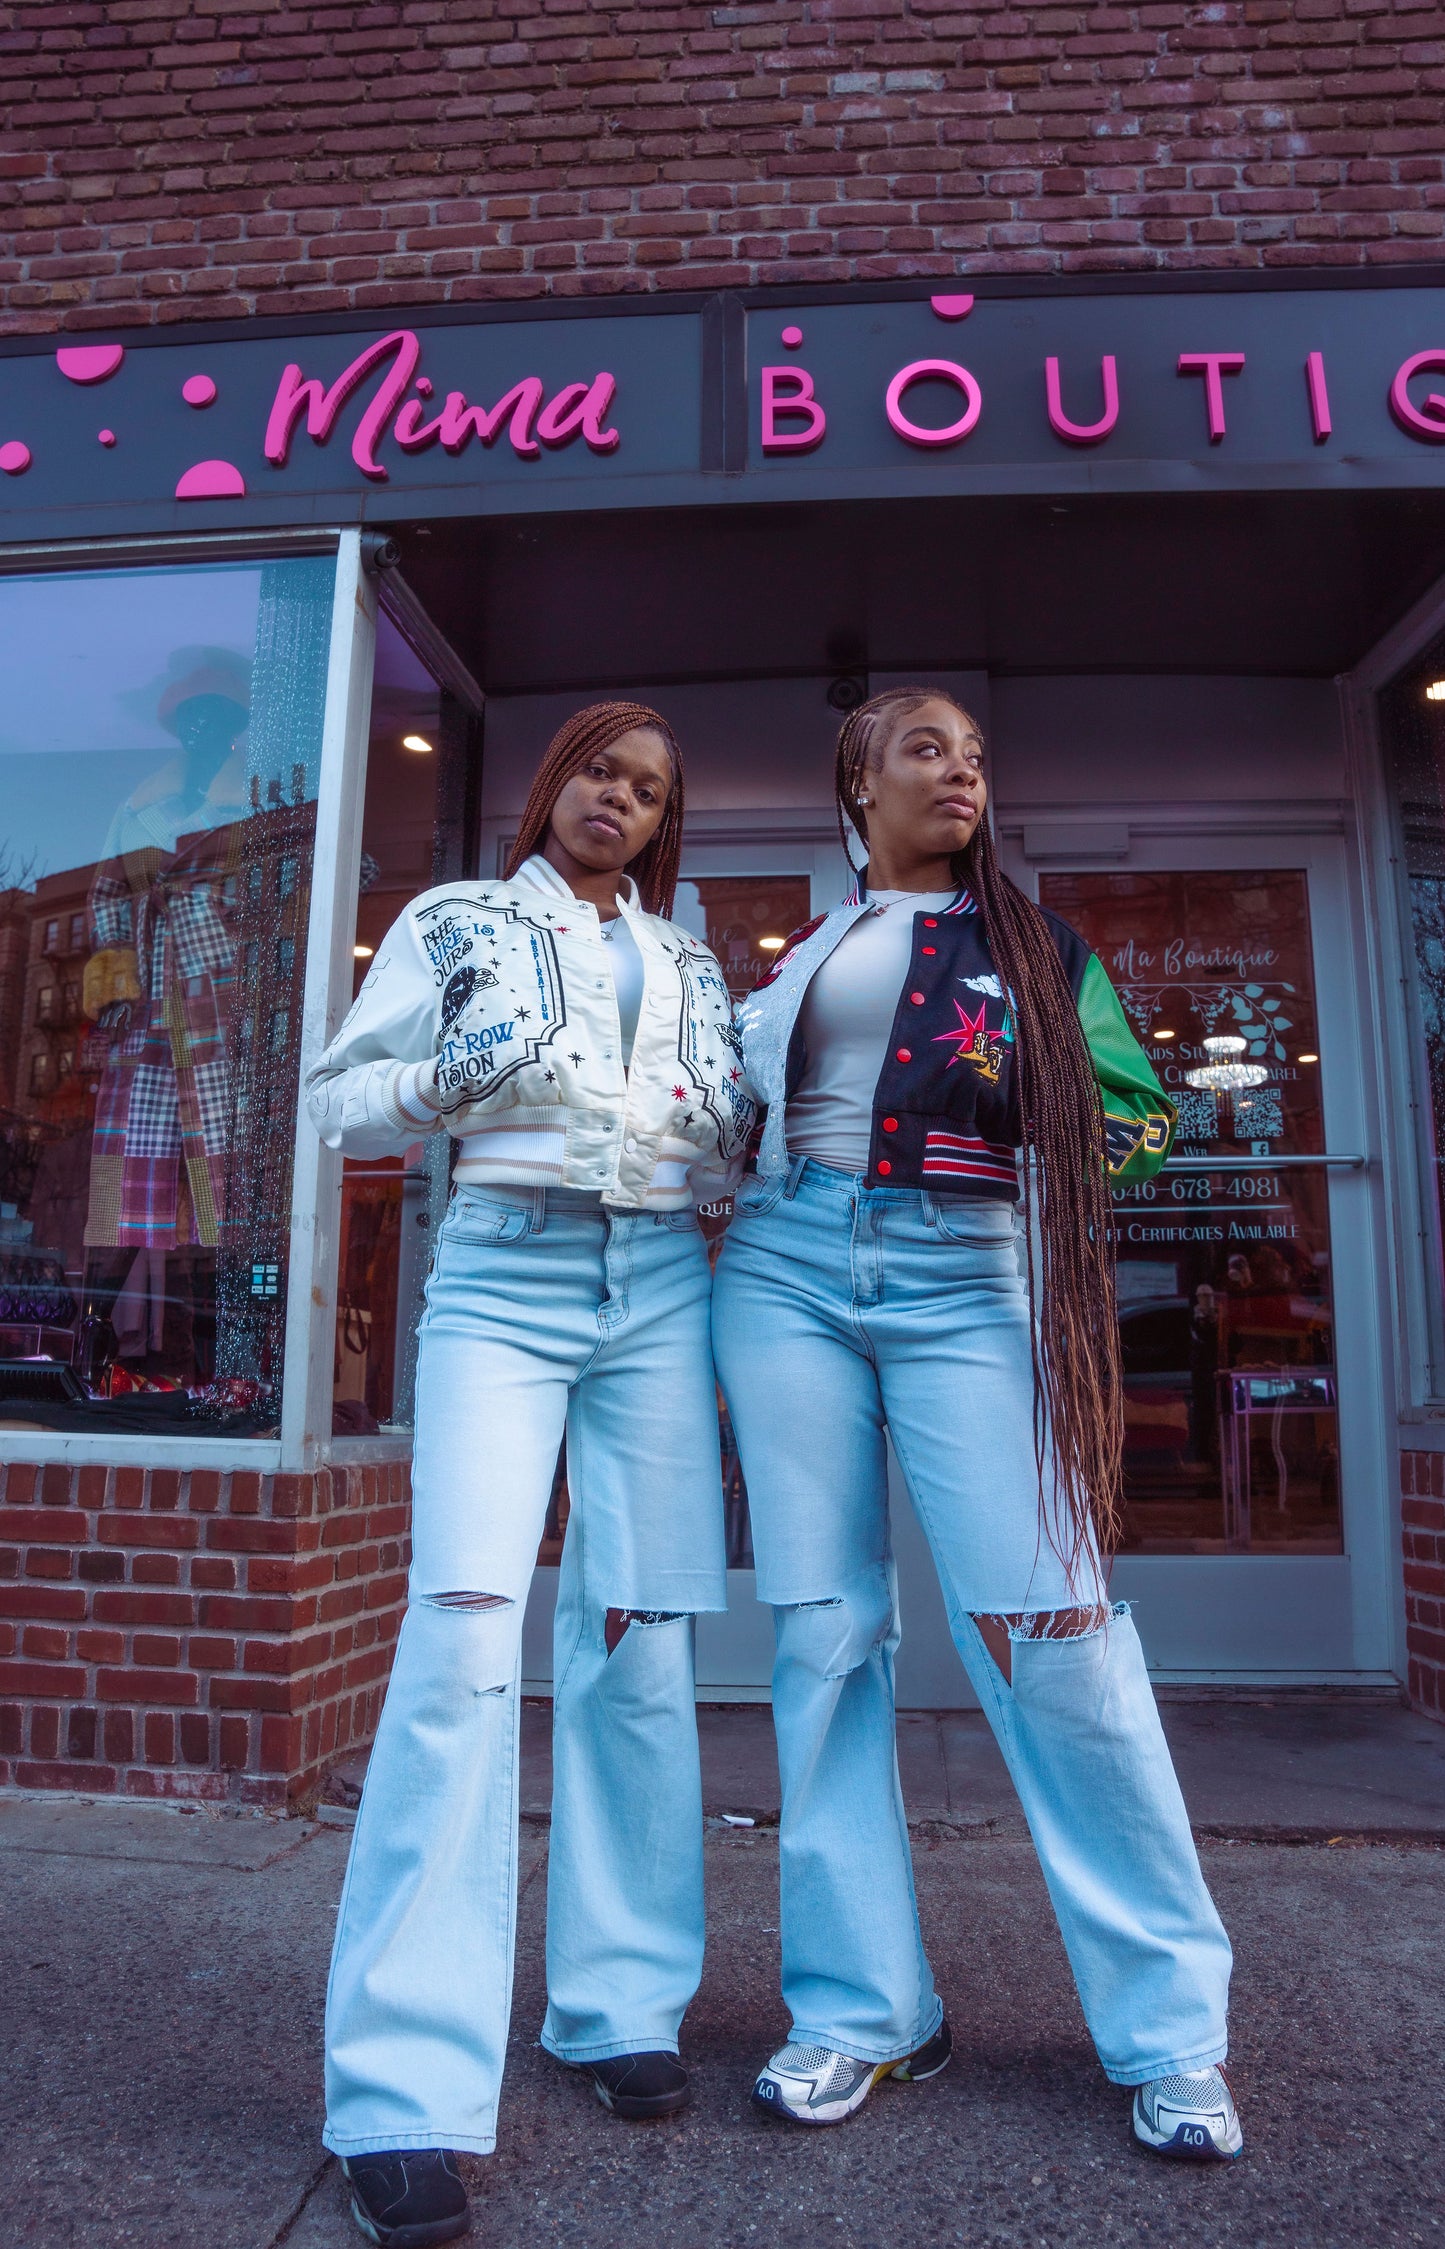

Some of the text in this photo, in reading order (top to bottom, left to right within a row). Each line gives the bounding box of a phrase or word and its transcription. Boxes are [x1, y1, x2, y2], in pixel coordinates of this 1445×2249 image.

[264, 329, 621, 482] Mima
[472, 923, 495, 937] IS
[530, 933, 550, 1021] INSPIRATION
[1113, 937, 1280, 980] Ma Boutique
[464, 1021, 516, 1056] ROW
[438, 1050, 496, 1091] ISION
[758, 2081, 774, 2100] 40
[1183, 2127, 1204, 2146] 40
